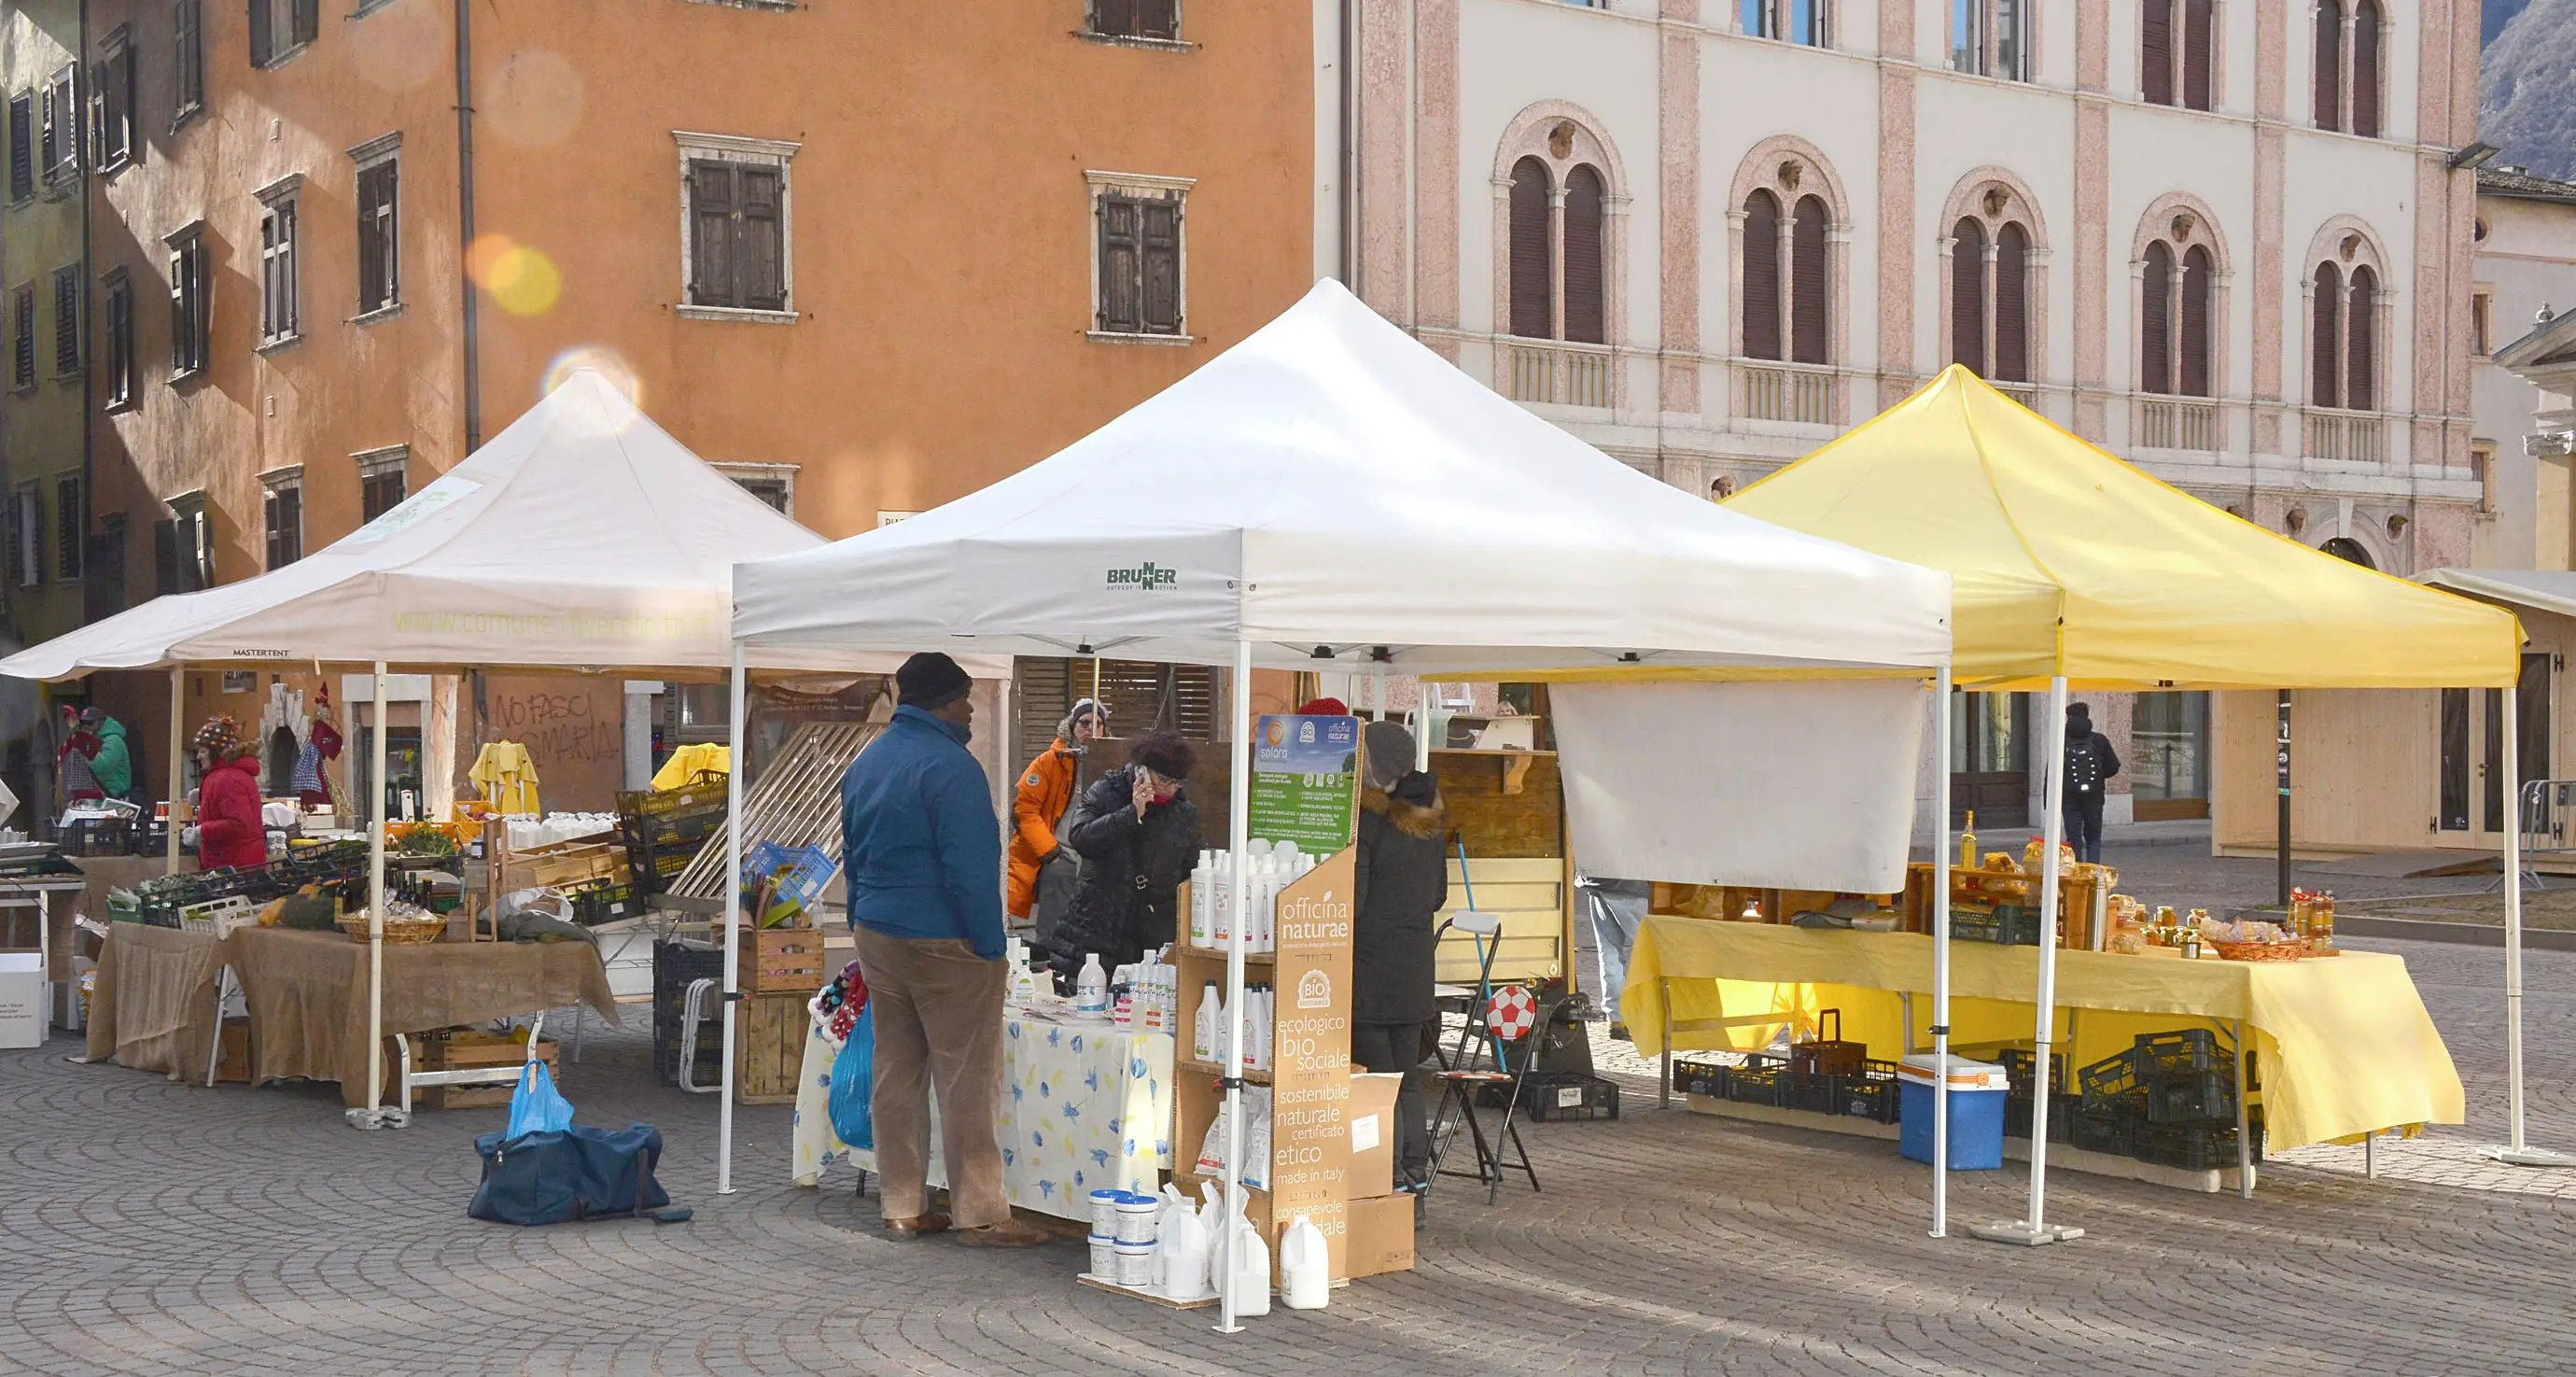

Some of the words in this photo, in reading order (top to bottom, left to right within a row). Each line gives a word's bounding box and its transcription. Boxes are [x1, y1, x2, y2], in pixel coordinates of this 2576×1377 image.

[1282, 892, 1348, 920] officina
[1282, 921, 1348, 939] naturae
[1278, 1013, 1344, 1035] ecologico
[1283, 1029, 1315, 1057] bio
[1297, 1047, 1350, 1070] sociale
[1280, 1082, 1350, 1103] sostenibile
[1277, 1103, 1340, 1126] naturale
[1292, 1124, 1345, 1140] certificato
[1276, 1141, 1322, 1165] etico
[1277, 1169, 1308, 1184] made
[1310, 1167, 1320, 1182] in
[1323, 1166, 1345, 1182] italy
[1276, 1200, 1343, 1219] consapevole
